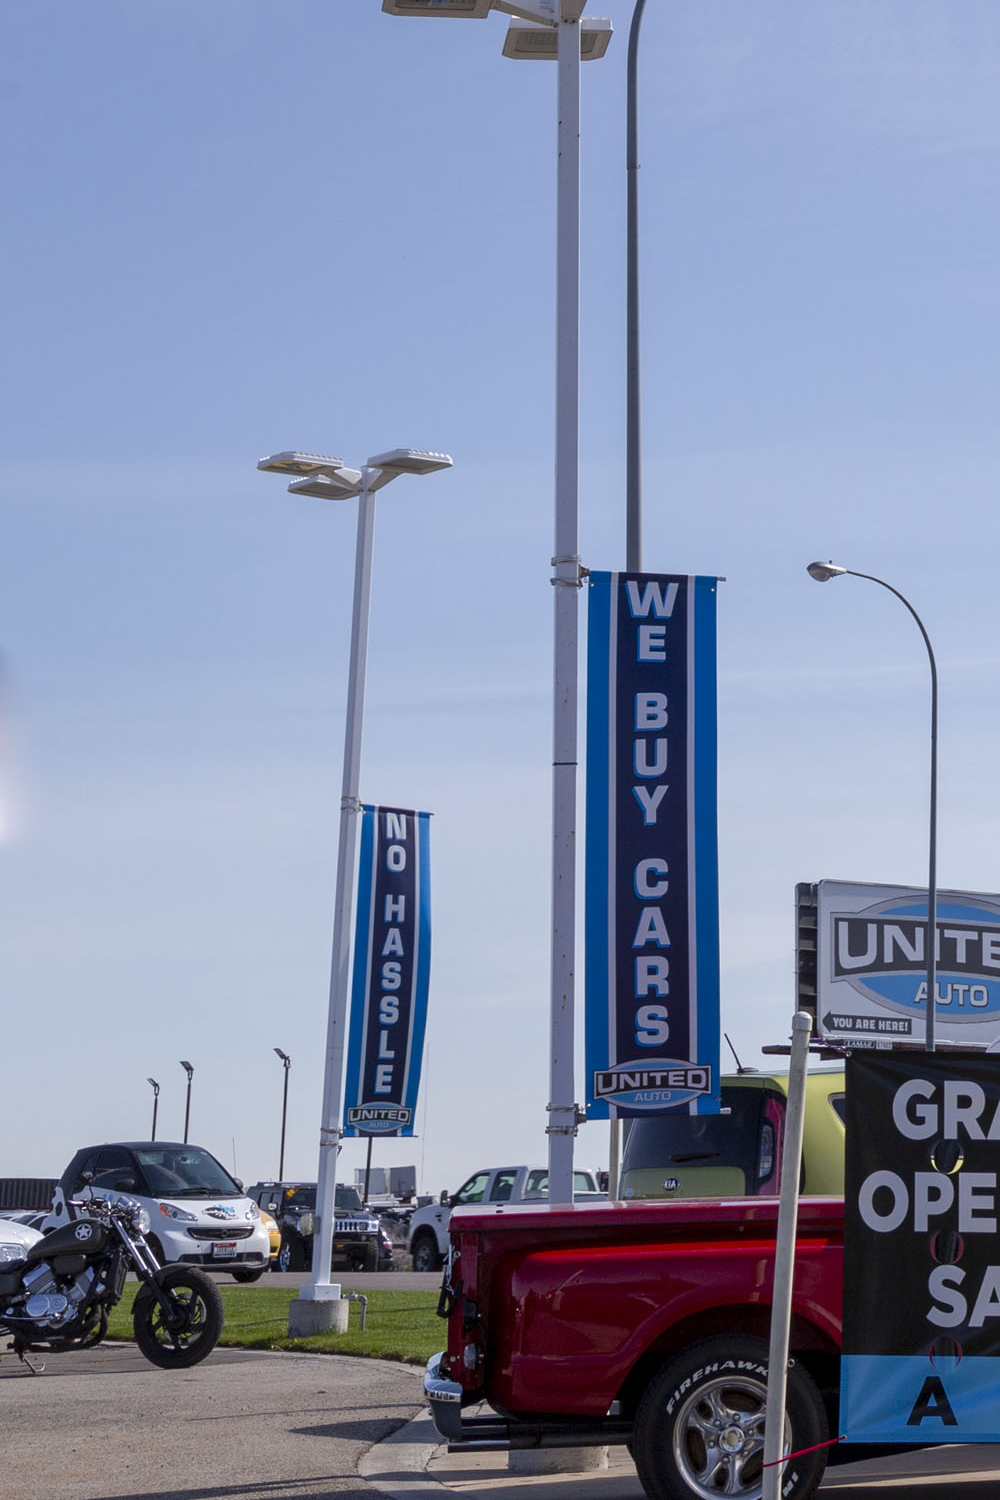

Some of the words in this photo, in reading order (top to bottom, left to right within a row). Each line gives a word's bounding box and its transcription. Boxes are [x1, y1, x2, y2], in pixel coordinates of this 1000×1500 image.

[624, 580, 679, 662] WE
[631, 692, 670, 826] BUY
[385, 812, 406, 874] NO
[631, 858, 671, 1048] CARS
[374, 893, 406, 1095] HASSLE
[914, 982, 989, 1007] AUTO
[832, 1017, 853, 1029] YOU
[855, 1018, 876, 1030] ARE
[878, 1020, 909, 1032] HERE!
[597, 1069, 707, 1095] UNITED
[633, 1091, 672, 1102] AUTO
[350, 1110, 409, 1122] UNITED
[663, 1179, 677, 1189] KIA
[666, 1360, 769, 1415] FIREHAWK
